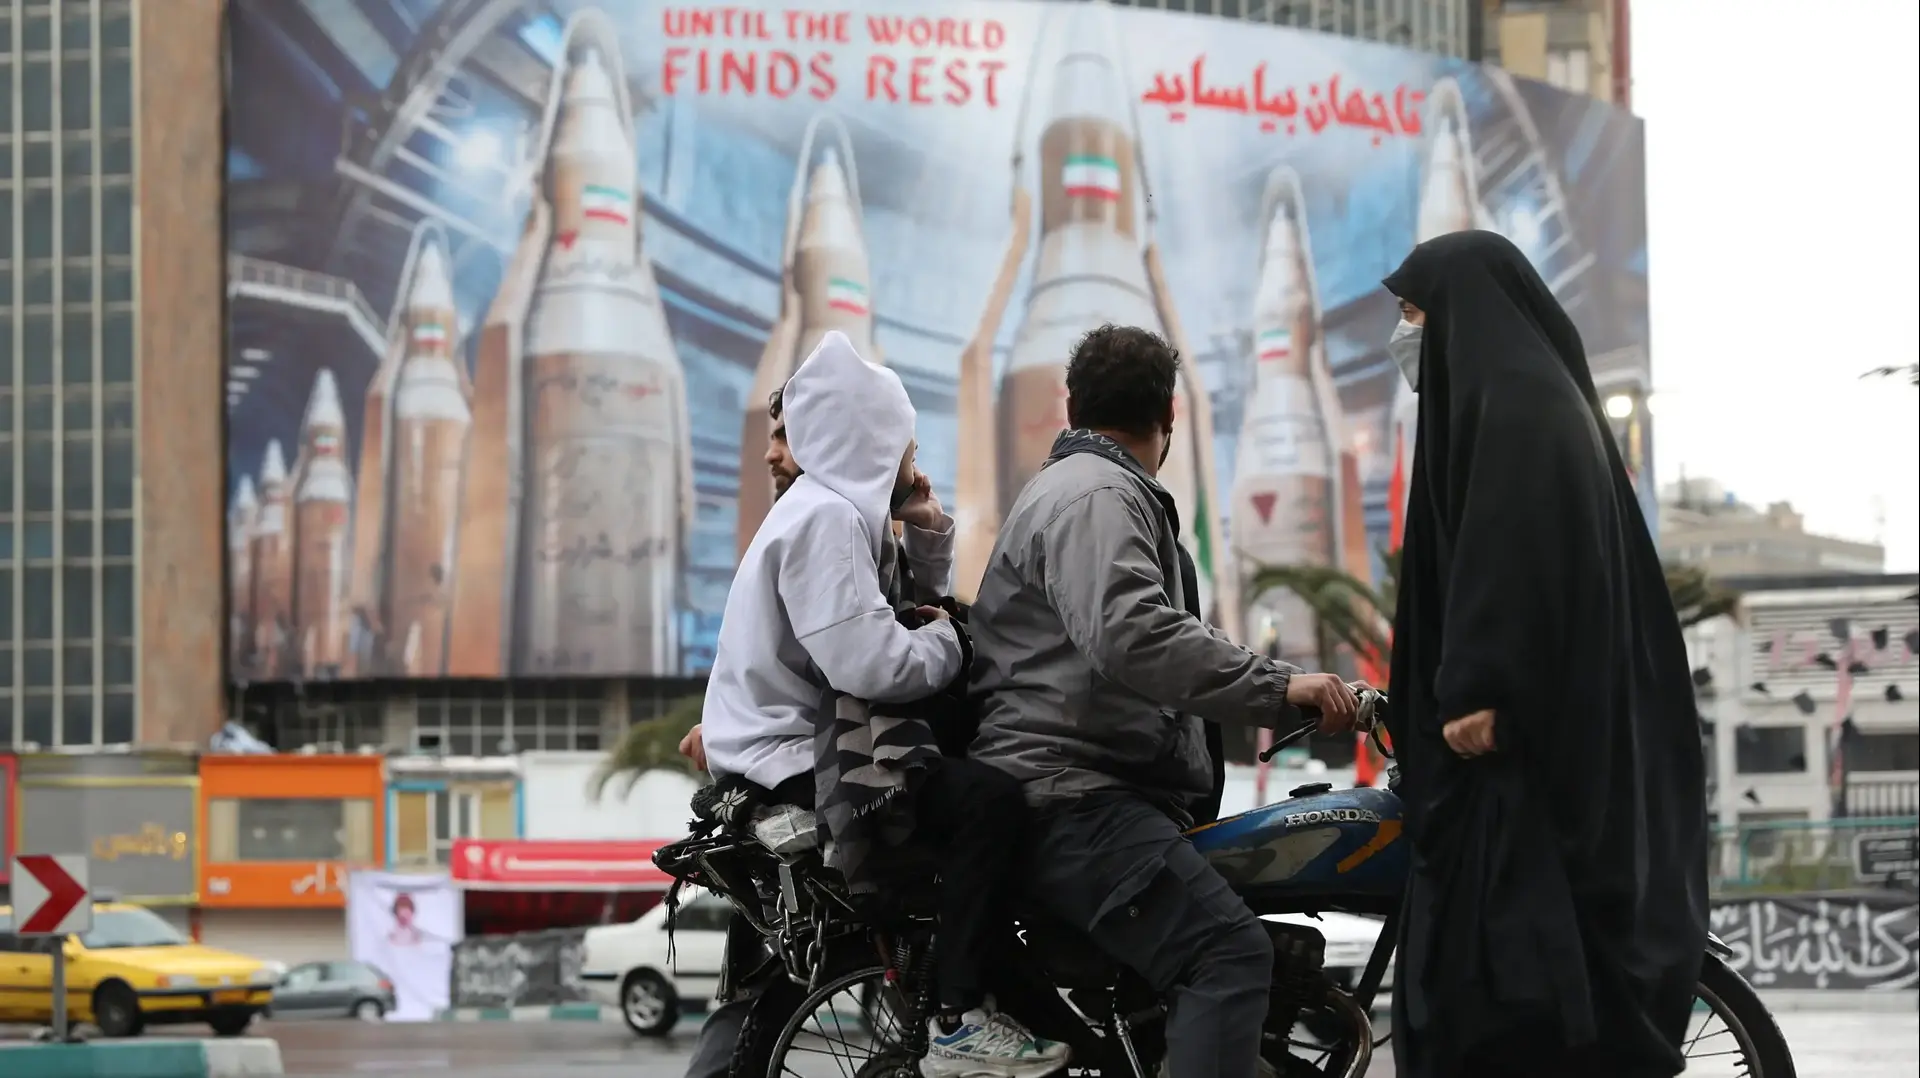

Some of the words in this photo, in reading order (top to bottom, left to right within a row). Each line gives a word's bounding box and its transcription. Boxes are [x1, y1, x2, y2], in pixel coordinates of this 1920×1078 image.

[662, 9, 771, 40] UNTIL
[783, 11, 850, 43] THE
[866, 15, 1005, 50] WORLD
[662, 48, 837, 100] FINDS
[867, 55, 1006, 107] REST
[1303, 74, 1396, 146] جهان
[1393, 85, 1426, 136] تا
[1284, 808, 1381, 828] HONDA
